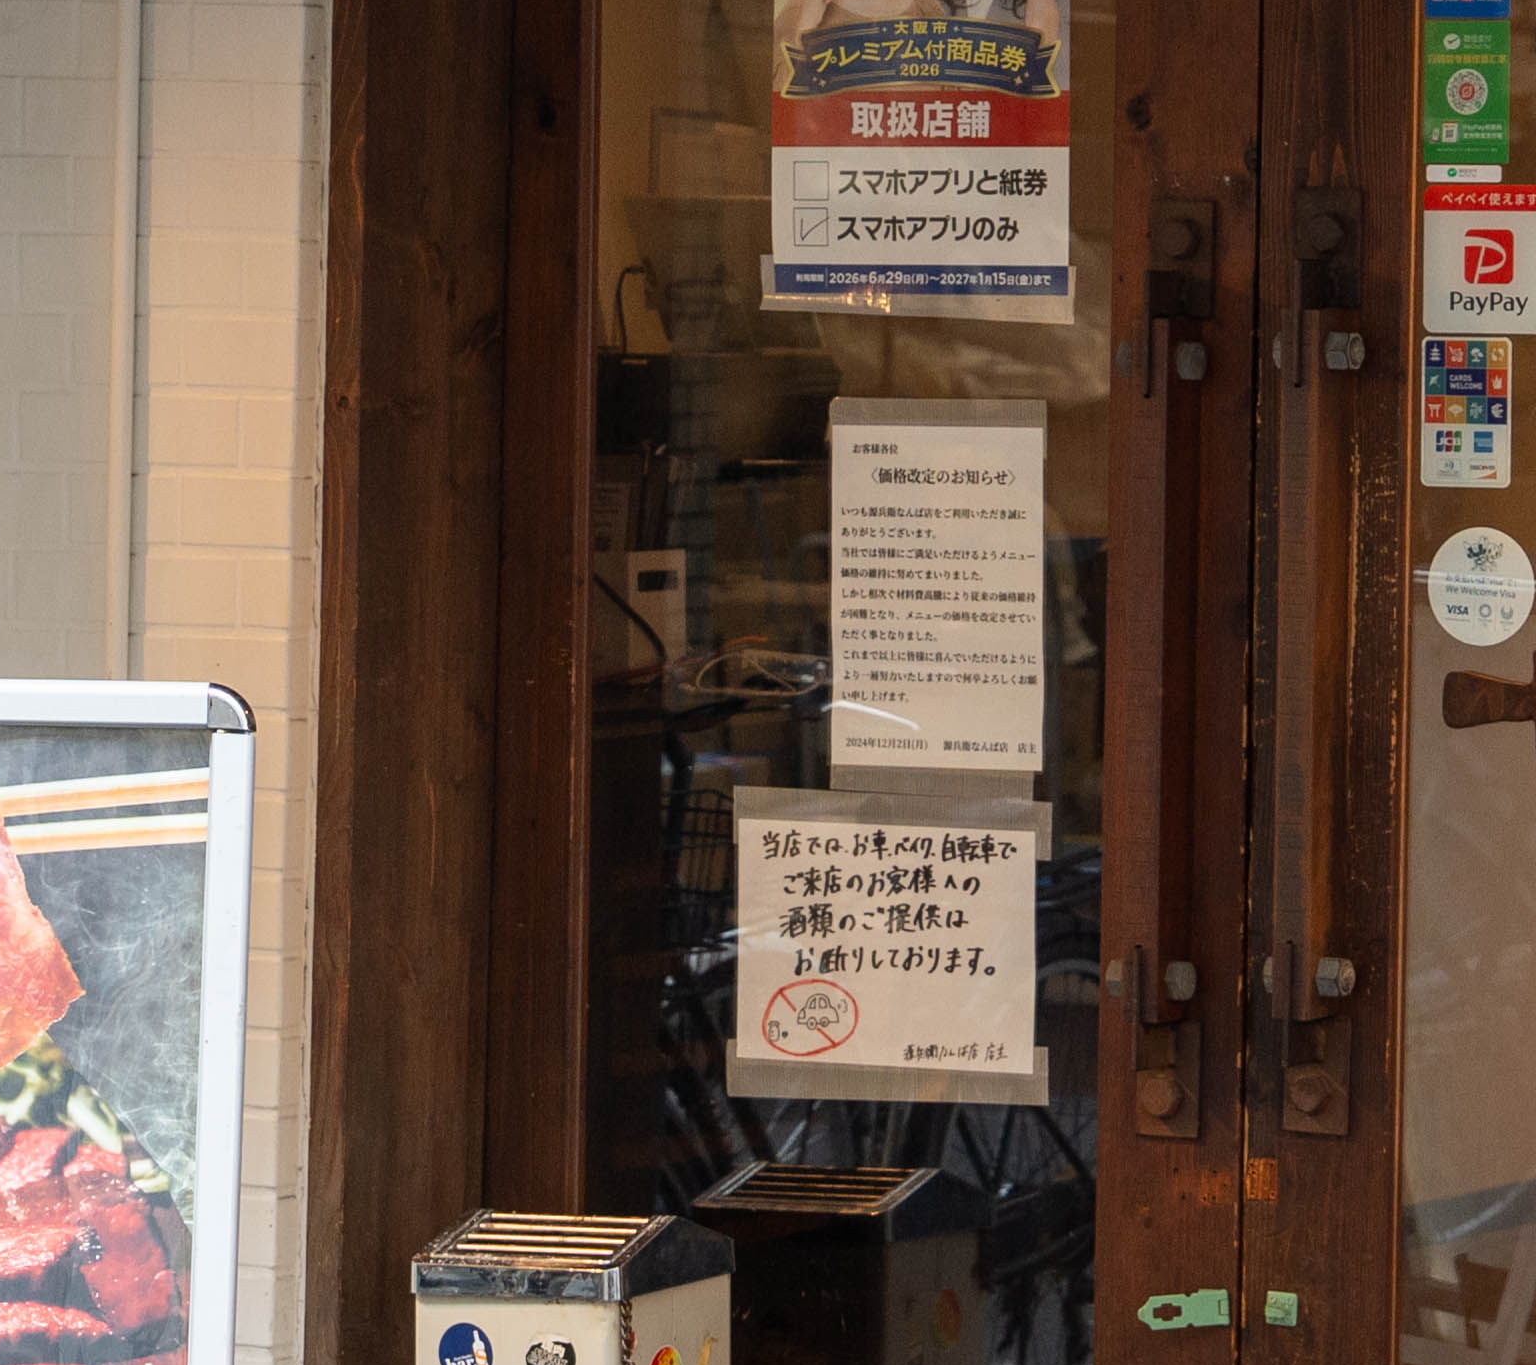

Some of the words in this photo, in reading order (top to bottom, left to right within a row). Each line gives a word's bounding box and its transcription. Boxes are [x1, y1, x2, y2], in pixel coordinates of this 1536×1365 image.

[894, 22, 948, 34] 大阪市
[811, 38, 1027, 74] プレミアム付商品券
[900, 64, 940, 77] 2026
[851, 101, 992, 139] 取扱店舗
[838, 169, 1048, 196] スマホアプリと紙券
[837, 215, 1020, 241] スマホアプリのみ
[1450, 291, 1528, 315] PayPay
[1446, 604, 1469, 615] VISA
[783, 864, 981, 897] ご来店のお客様への
[779, 902, 969, 938] 酒類のご提供は
[794, 945, 996, 976] お断りしております。
